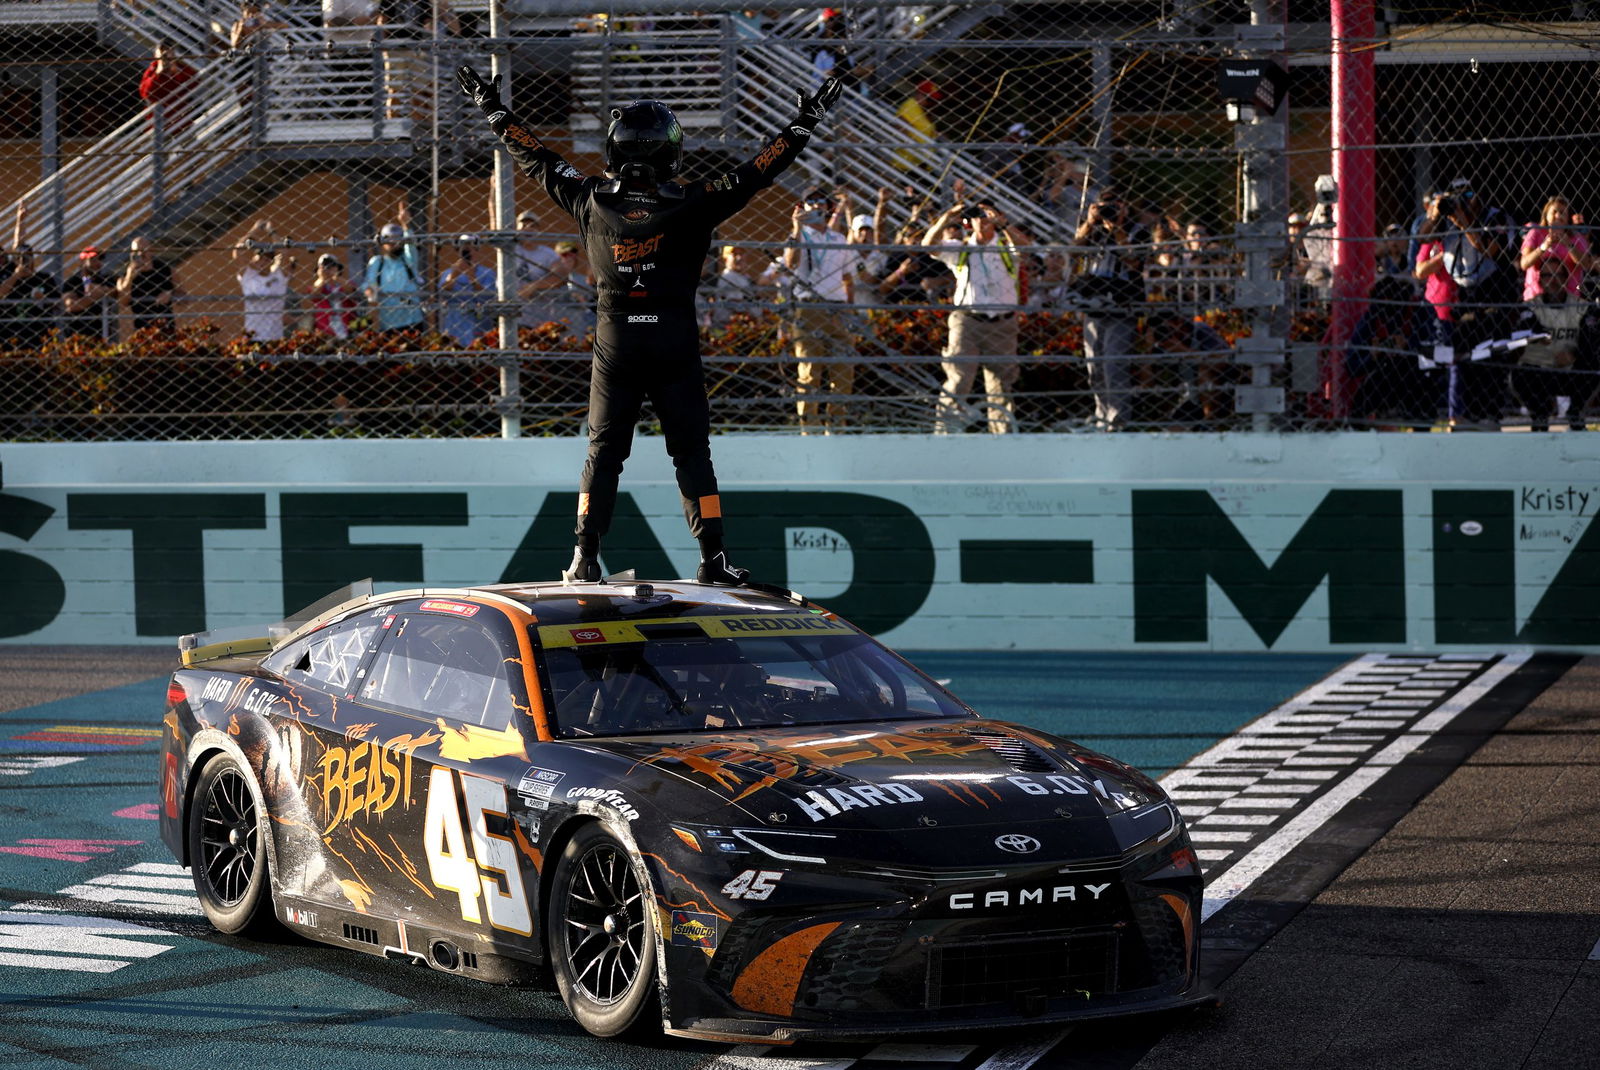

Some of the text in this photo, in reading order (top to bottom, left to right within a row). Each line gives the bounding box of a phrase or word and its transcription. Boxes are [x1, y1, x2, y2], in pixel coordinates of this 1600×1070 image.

[505, 123, 546, 151] BEAST
[753, 137, 790, 174] BEAST
[612, 234, 665, 264] BEAST
[618, 262, 656, 273] HARD 6.0%
[627, 315, 659, 323] sparco
[1521, 486, 1589, 517] Kristy
[719, 616, 842, 632] REDDICK
[201, 676, 280, 716] HARD 6.0%
[345, 722, 379, 742] THE
[318, 728, 442, 835] BEAST
[522, 781, 551, 795] CUP SERIES
[535, 770, 559, 781] NASCAR
[566, 786, 640, 822] GOODYEAR
[794, 781, 924, 823] HARD
[424, 765, 534, 938] 45
[721, 869, 785, 901] 45
[949, 882, 1112, 910] CAMRY
[286, 906, 309, 926] Mobil
[674, 924, 715, 937] SUNOCO
